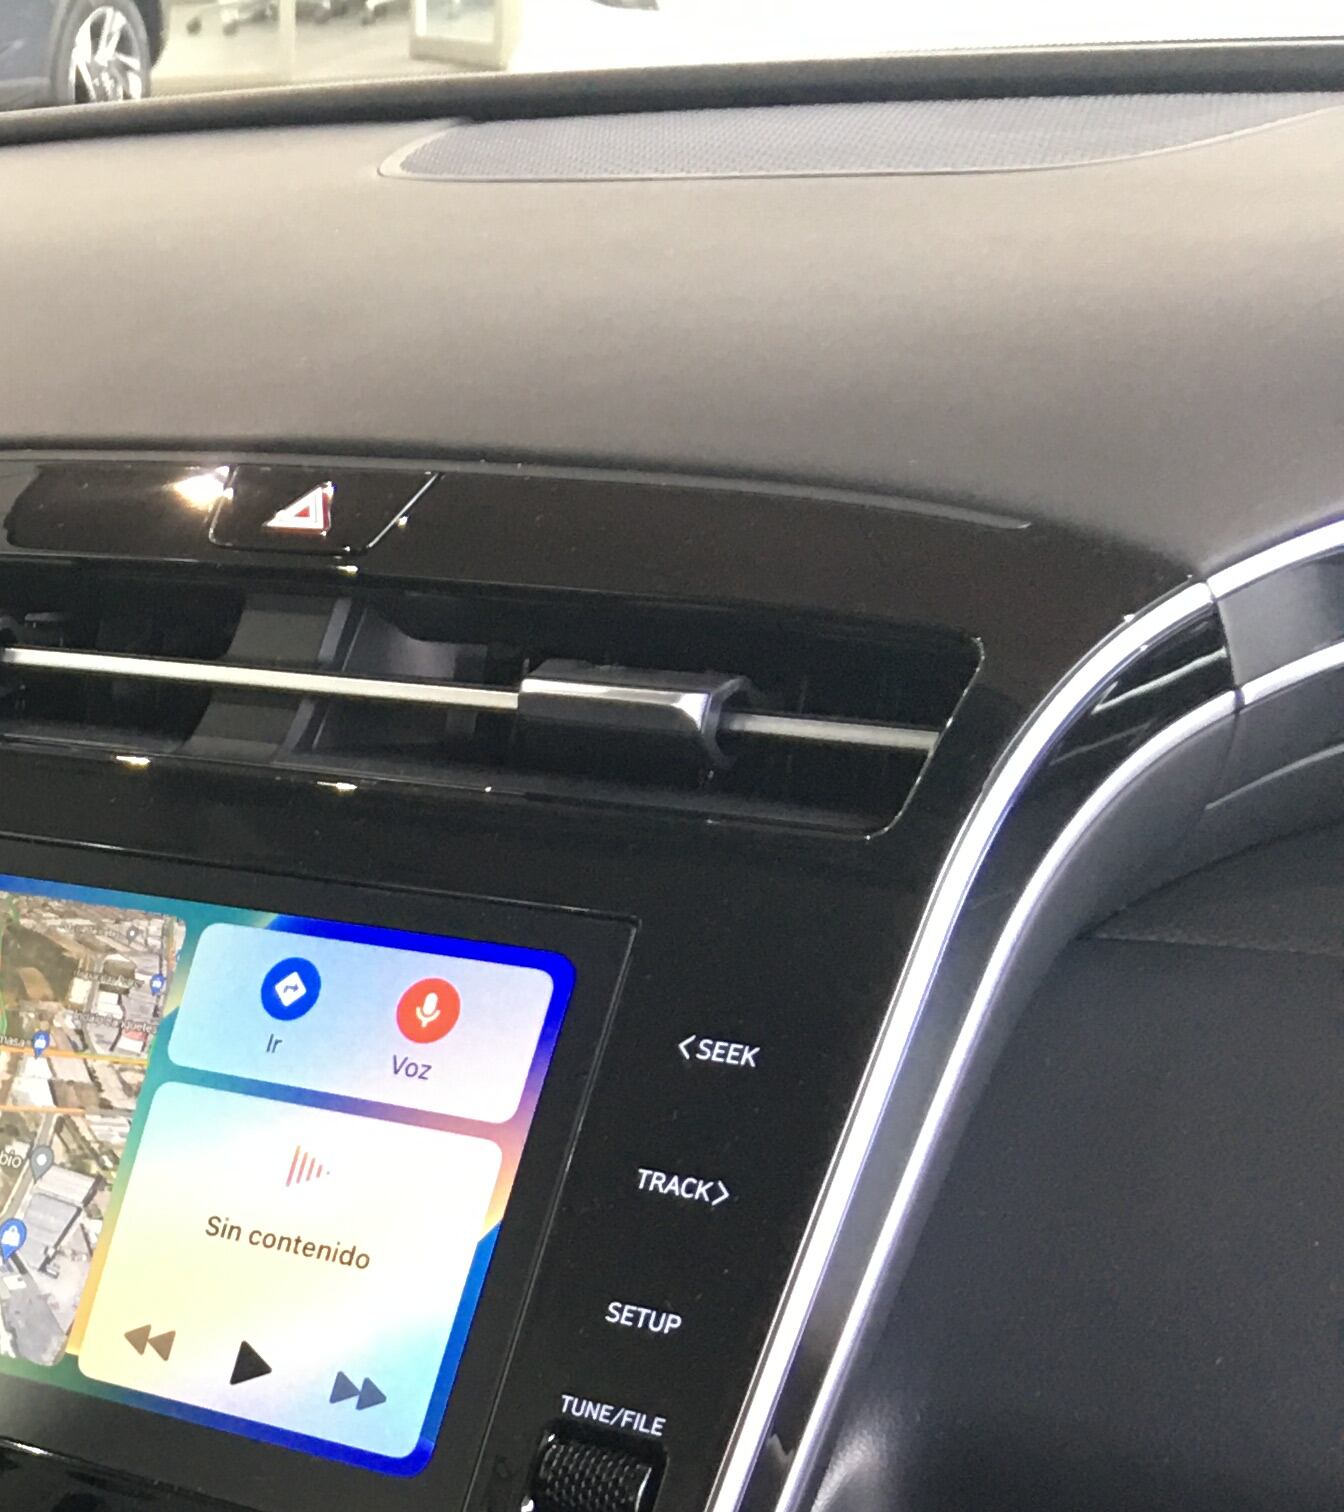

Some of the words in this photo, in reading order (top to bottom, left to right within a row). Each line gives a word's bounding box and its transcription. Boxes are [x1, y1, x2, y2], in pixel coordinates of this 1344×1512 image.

[266, 1034, 282, 1053] Ir
[392, 1054, 432, 1080] Voz
[205, 1216, 242, 1241] Sin
[249, 1229, 370, 1269] contenido
[605, 1302, 682, 1335] SETUP
[560, 1395, 666, 1436] TUNE/FILE
